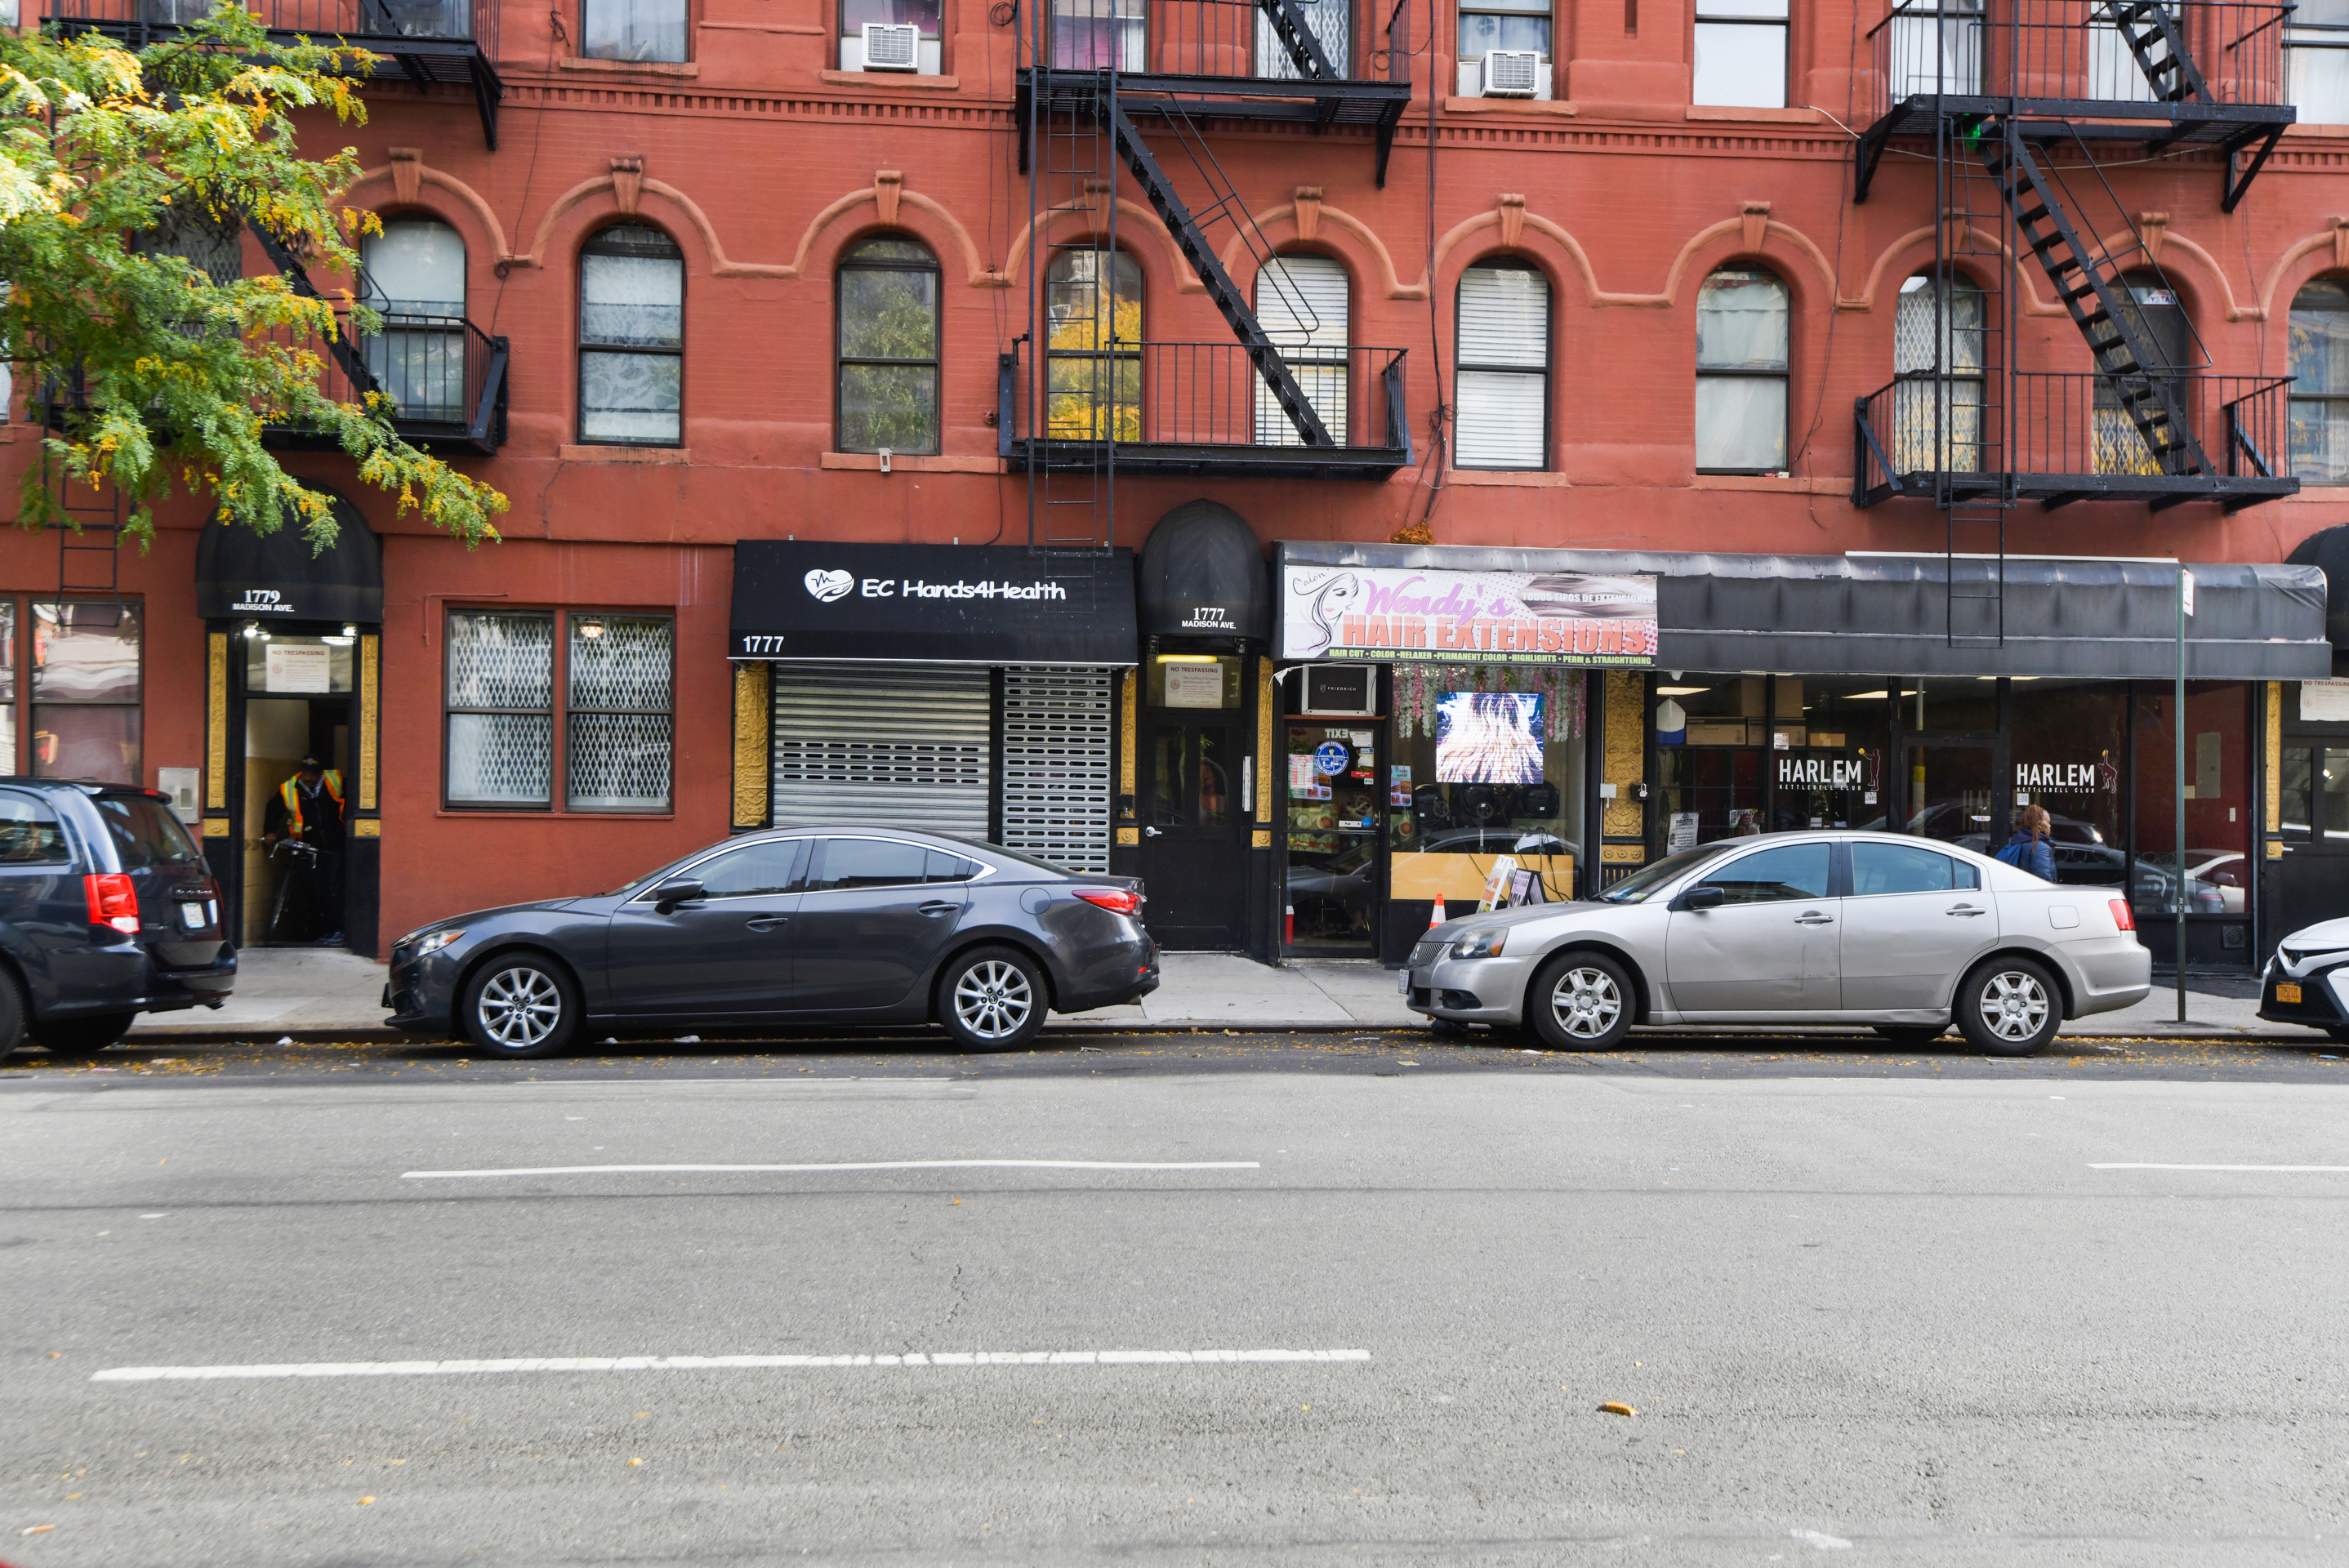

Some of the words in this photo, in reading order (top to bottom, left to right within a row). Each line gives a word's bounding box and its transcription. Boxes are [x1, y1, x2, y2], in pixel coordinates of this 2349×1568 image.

[243, 590, 281, 604] 1779
[861, 578, 895, 598] EC
[903, 579, 1067, 600] Hands4Health
[1522, 592, 1552, 602] TODOS
[1553, 593, 1582, 603] TIPOS
[1582, 594, 1593, 603] DE
[1595, 594, 1654, 604] EXTENSIONES
[232, 603, 272, 612] MADISON
[273, 604, 295, 612] AVE.
[1363, 576, 1515, 628] Wendy's
[1192, 607, 1225, 621] 1777
[1343, 614, 1426, 647] HAIR
[1436, 617, 1647, 653] EXTENSIONS
[742, 635, 784, 653] 1777
[1329, 648, 1347, 657] HAIR
[1348, 649, 1364, 658] CUT
[1370, 650, 1395, 658] COLOR
[1399, 651, 1432, 660] RELAXER
[1437, 652, 1482, 662] PERMANENT
[1482, 653, 1507, 662] COLOR
[1512, 654, 1557, 663] HIGHLIGHTS
[1562, 655, 1584, 663] PERM
[1585, 656, 1591, 664] &
[1593, 656, 1651, 665] STRAIGHTENING
[1779, 760, 1861, 783] HARLEM
[2017, 764, 2095, 786] HARLEM
